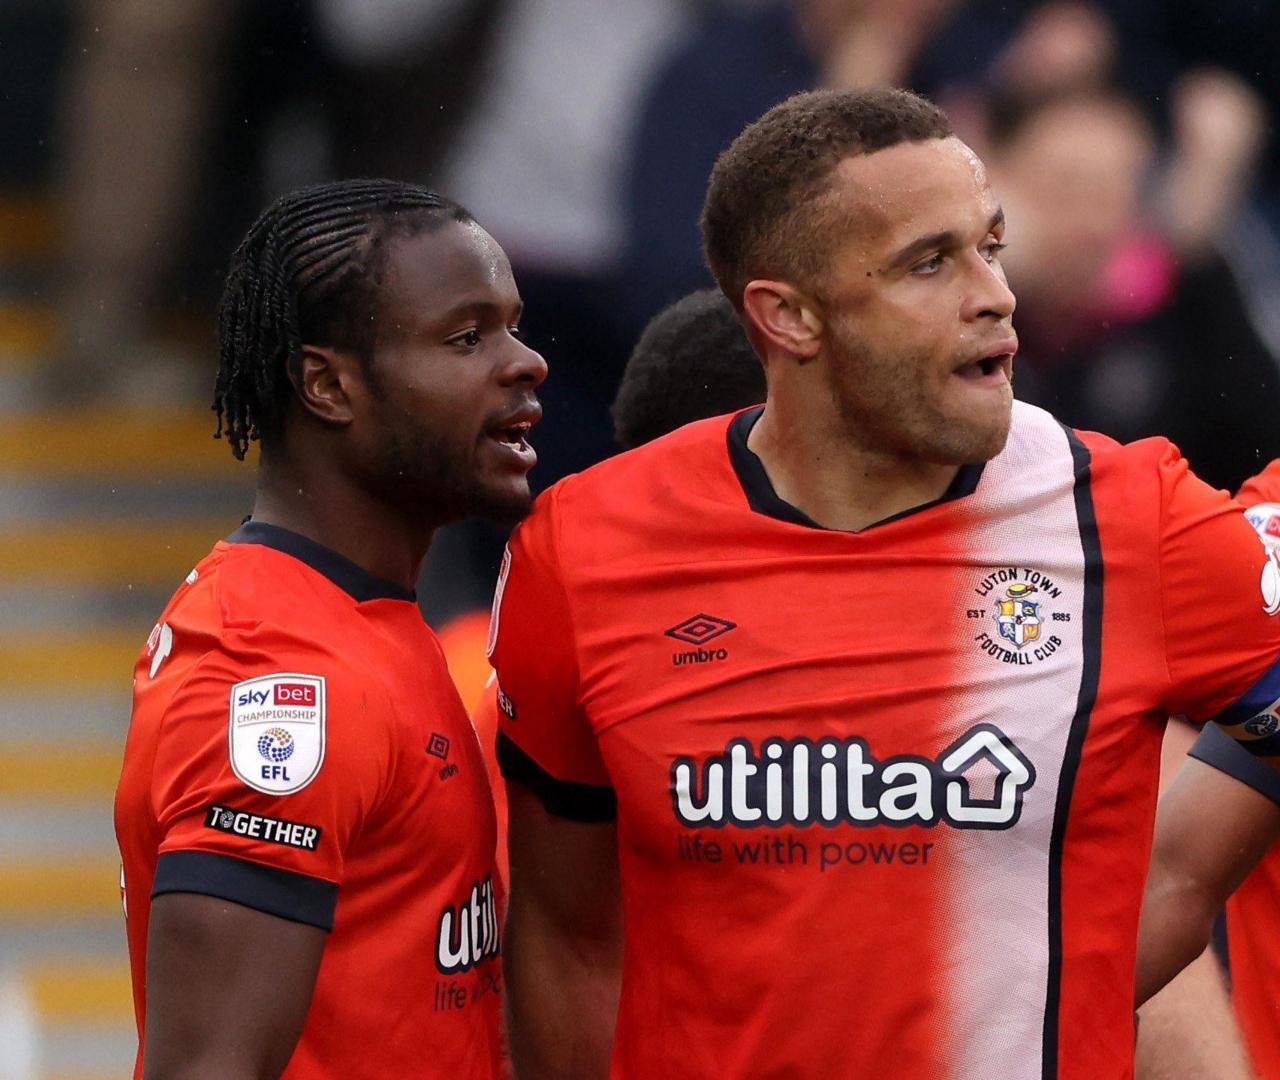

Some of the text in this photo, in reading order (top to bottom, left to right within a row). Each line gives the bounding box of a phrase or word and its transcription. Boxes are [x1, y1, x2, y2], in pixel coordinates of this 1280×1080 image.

[975, 568, 1062, 599] LUTON TOWN
[967, 609, 986, 619] EST
[672, 647, 728, 666] umbro
[974, 632, 1062, 665] FOOTBALL CLUB
[238, 685, 312, 707] sky bet
[237, 709, 317, 724] CHAMPIONSHIP
[261, 765, 291, 782] EFL
[673, 741, 936, 824] utilita
[677, 833, 935, 873] life with power
[434, 981, 467, 1012] life
